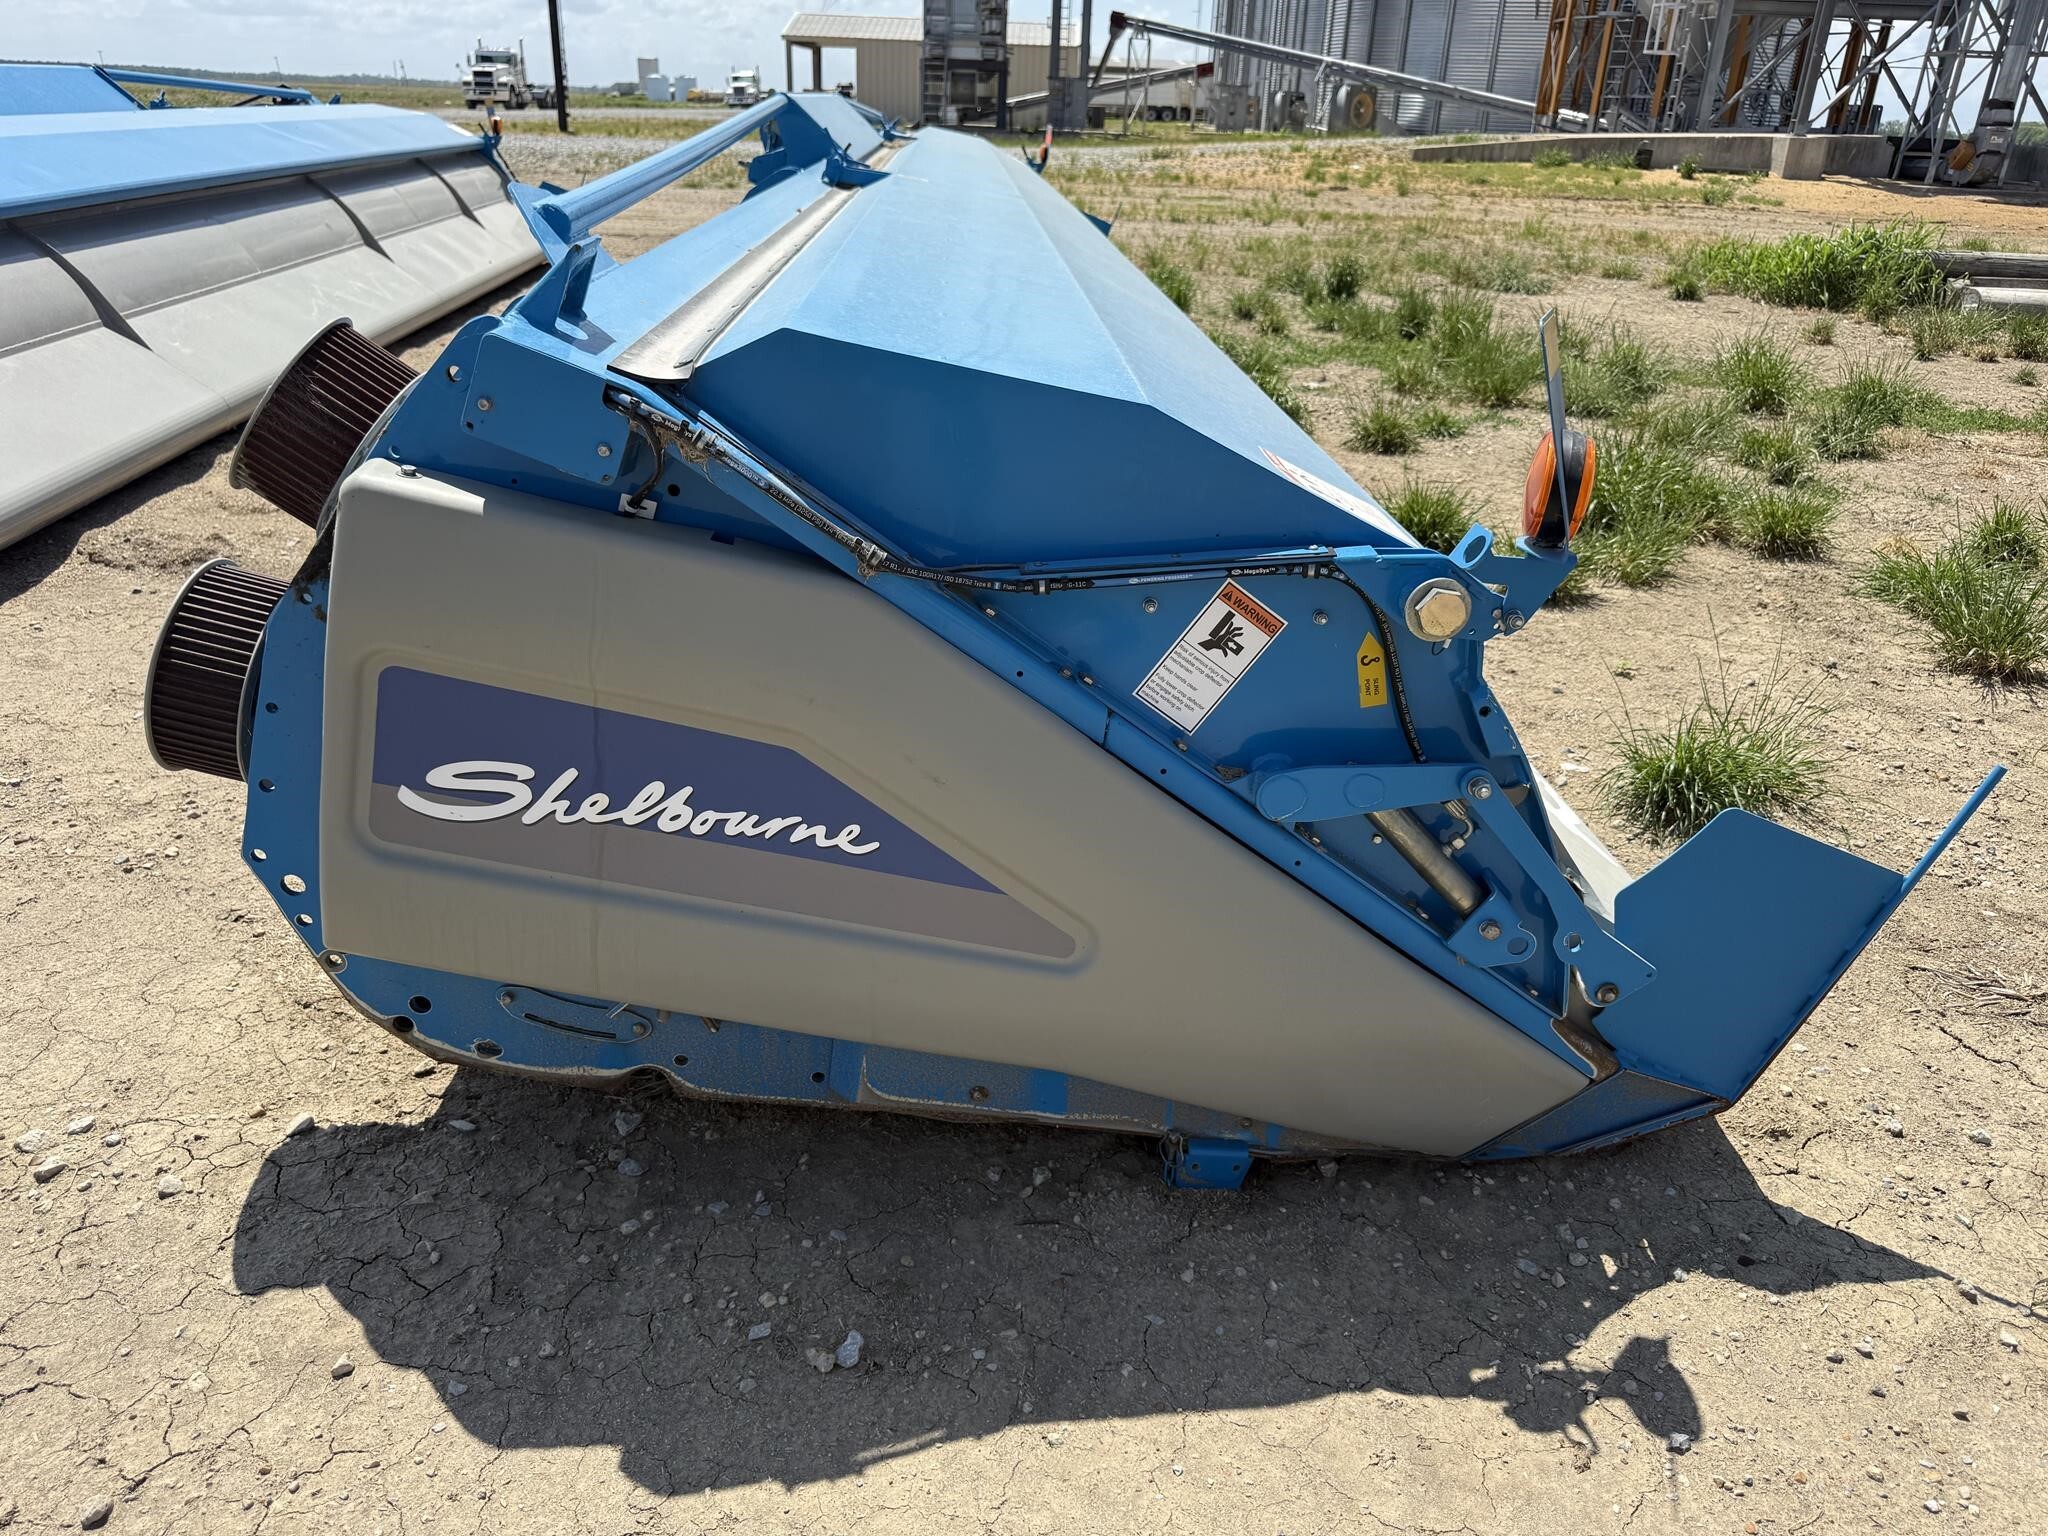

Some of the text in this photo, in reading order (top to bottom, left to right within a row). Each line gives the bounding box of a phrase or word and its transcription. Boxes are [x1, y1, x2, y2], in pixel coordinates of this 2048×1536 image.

[1234, 597, 1278, 634] WARNING
[1162, 664, 1174, 675] Keep
[396, 760, 881, 856] Shelbourne
